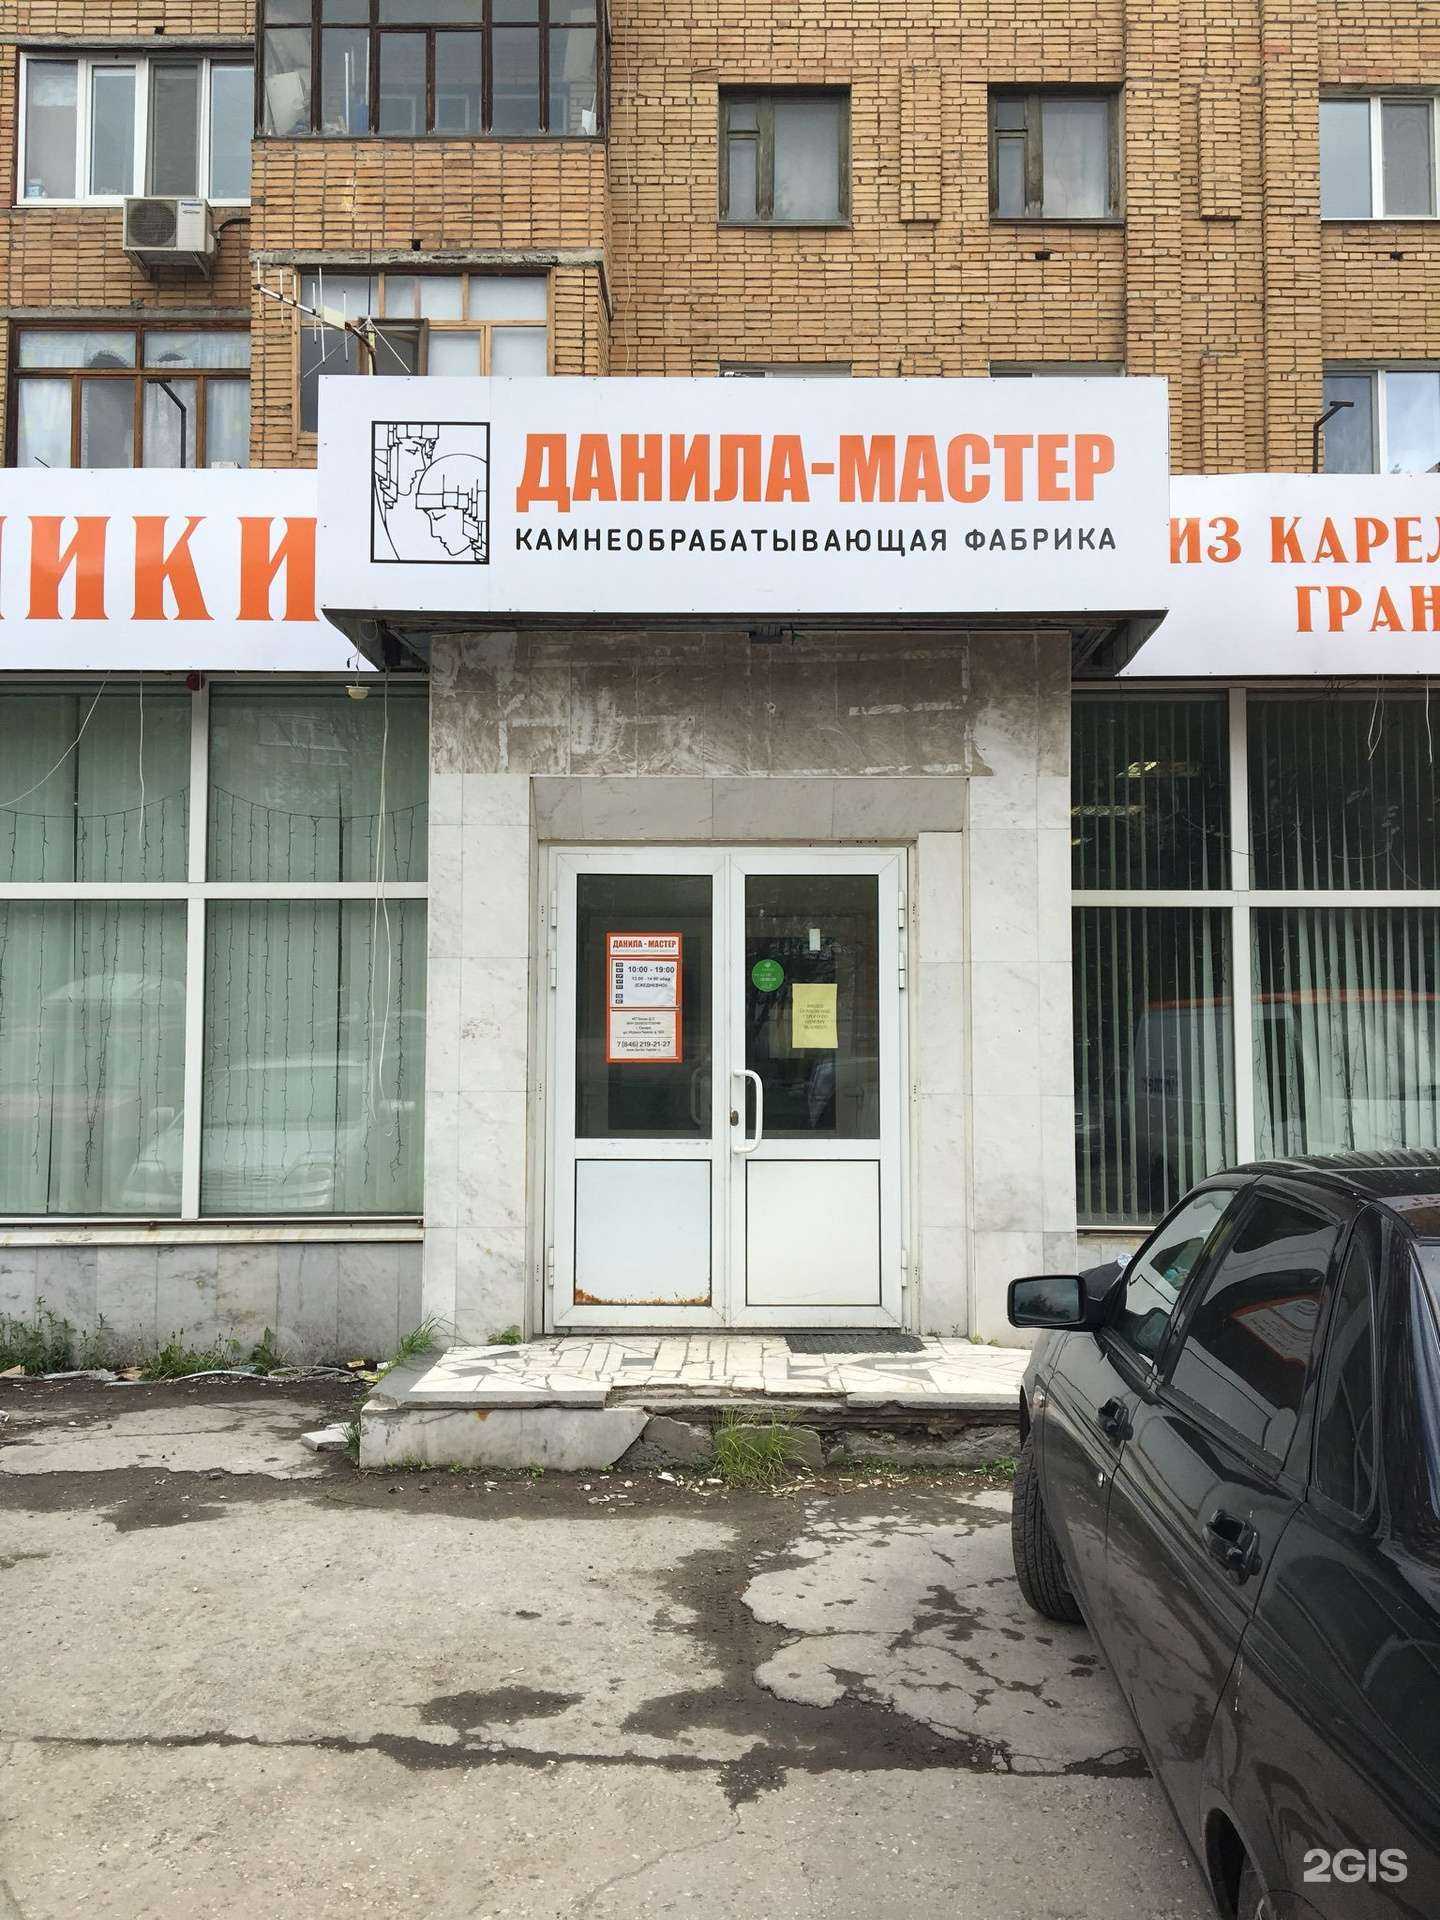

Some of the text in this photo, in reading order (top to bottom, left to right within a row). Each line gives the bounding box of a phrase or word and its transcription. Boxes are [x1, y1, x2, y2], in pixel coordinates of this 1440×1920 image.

[516, 433, 1115, 512] ДАНИЛА-МАСТЕР
[515, 527, 1116, 557] КАМНЕОБРАБАТЫВАЮЩАЯ ФАБРИКА
[1169, 516, 1241, 564] ИЗ
[0, 516, 319, 622] ИКИ
[613, 940, 643, 948] ДАНИЛА
[648, 940, 677, 948] МАСТЕР
